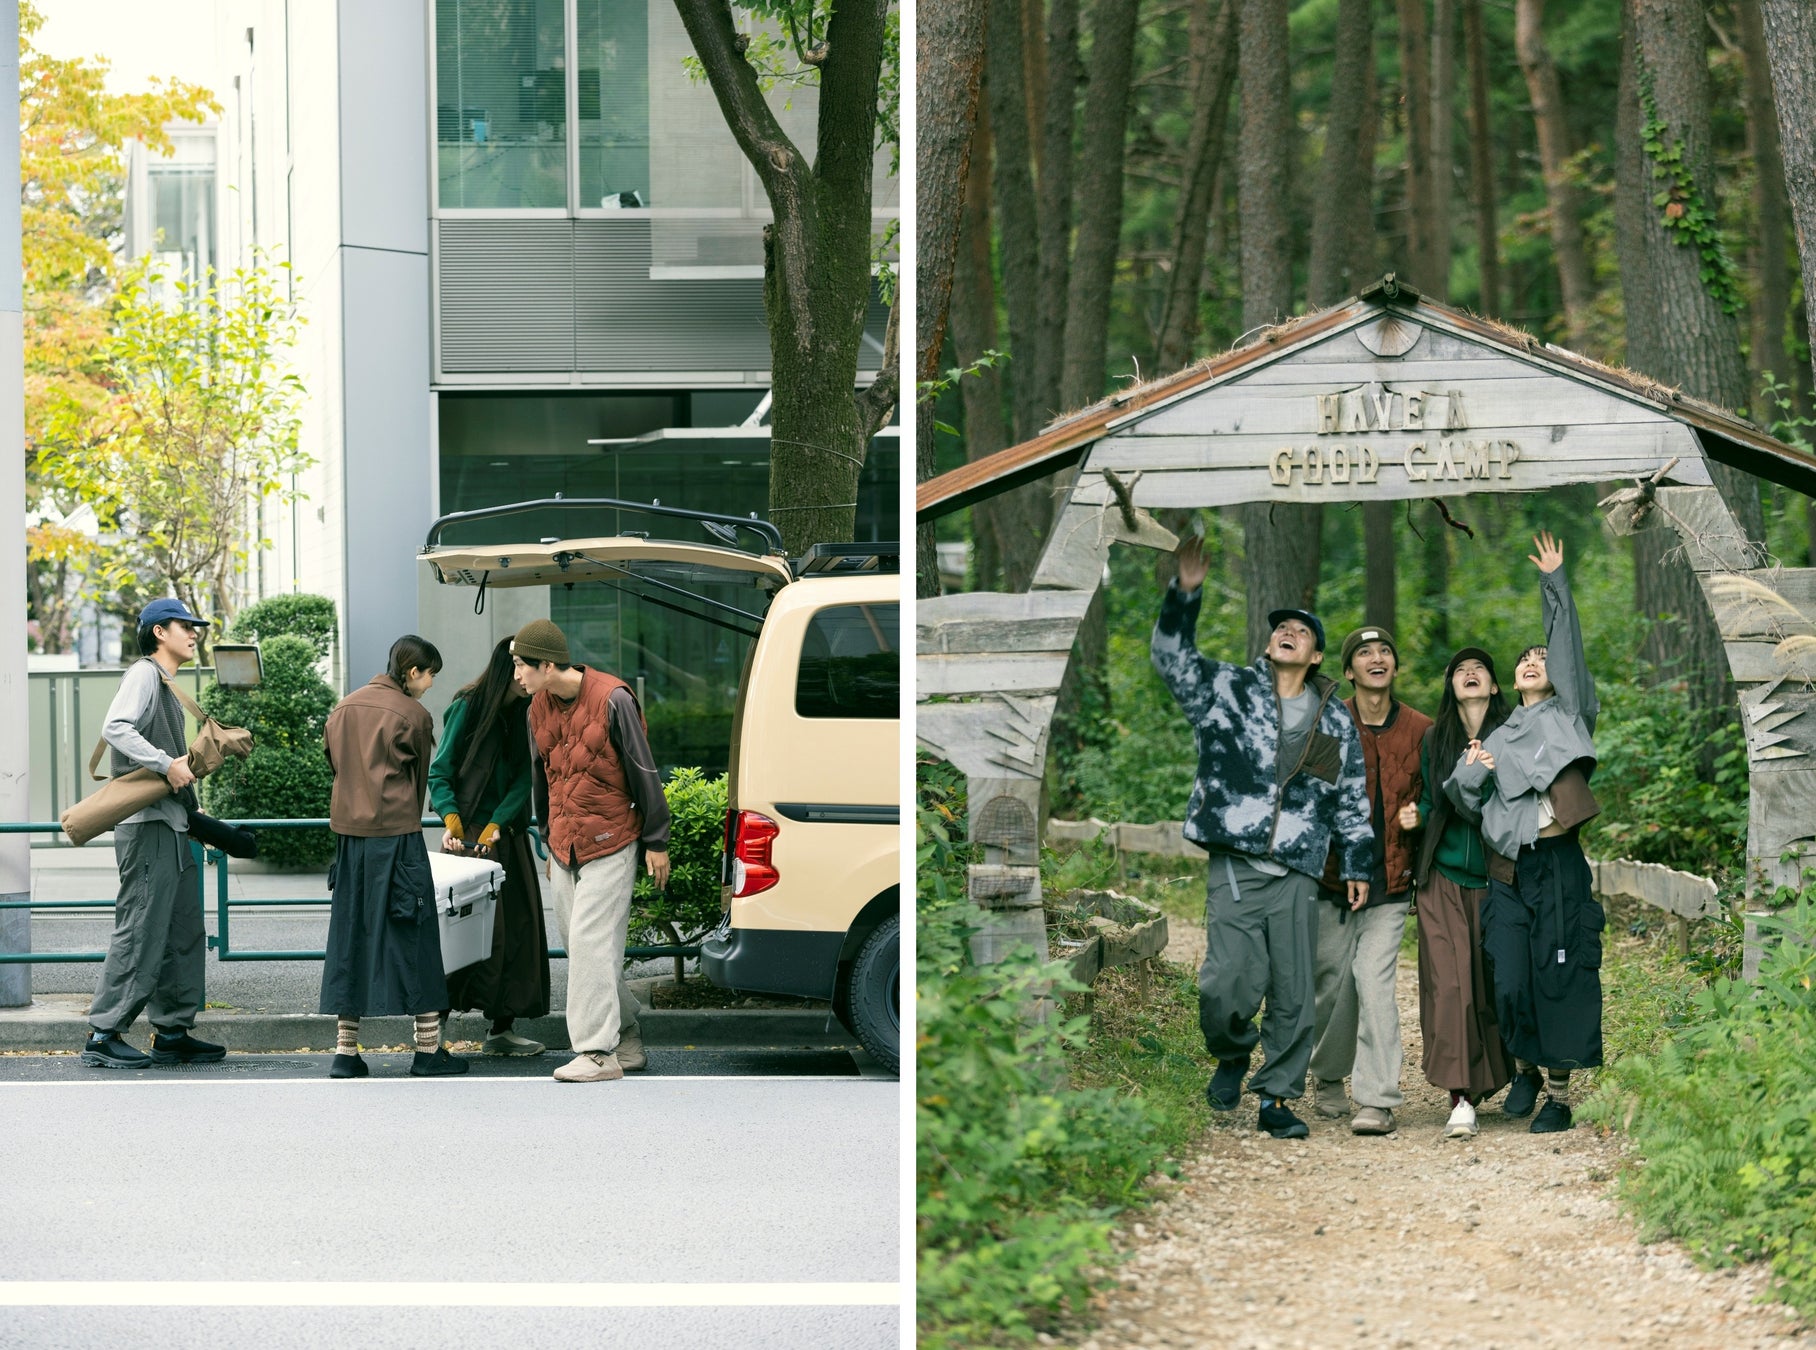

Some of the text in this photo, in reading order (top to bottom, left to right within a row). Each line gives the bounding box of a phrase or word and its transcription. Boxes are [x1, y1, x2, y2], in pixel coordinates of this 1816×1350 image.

[1316, 389, 1469, 435] HAVE A
[1269, 438, 1520, 486] GOOD CAMP
